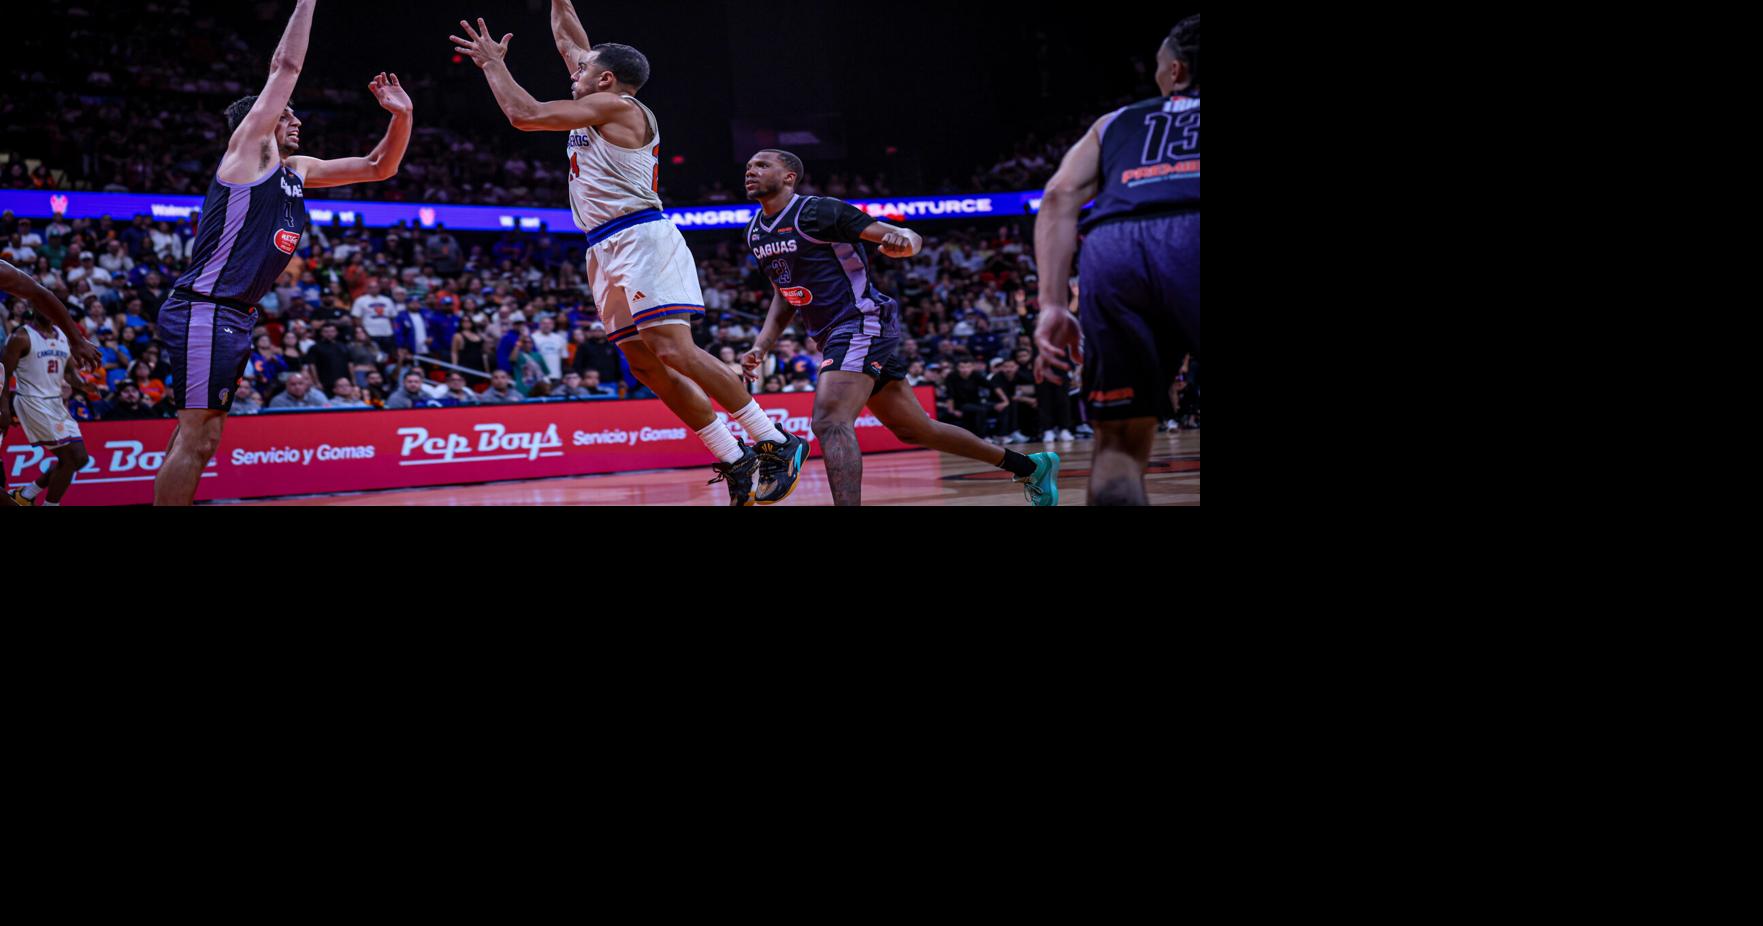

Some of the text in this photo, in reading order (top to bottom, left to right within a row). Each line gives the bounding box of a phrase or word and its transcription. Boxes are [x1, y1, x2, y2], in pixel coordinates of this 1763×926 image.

[1142, 111, 1200, 165] 13
[867, 198, 992, 218] SANTURCE
[753, 239, 798, 260] CAGUAS
[47, 359, 59, 374] 21
[397, 423, 687, 461] Pep Boys Servicio y Gomas
[231, 447, 300, 465] Servicio
[302, 449, 314, 466] y
[316, 443, 376, 460] Gomas
